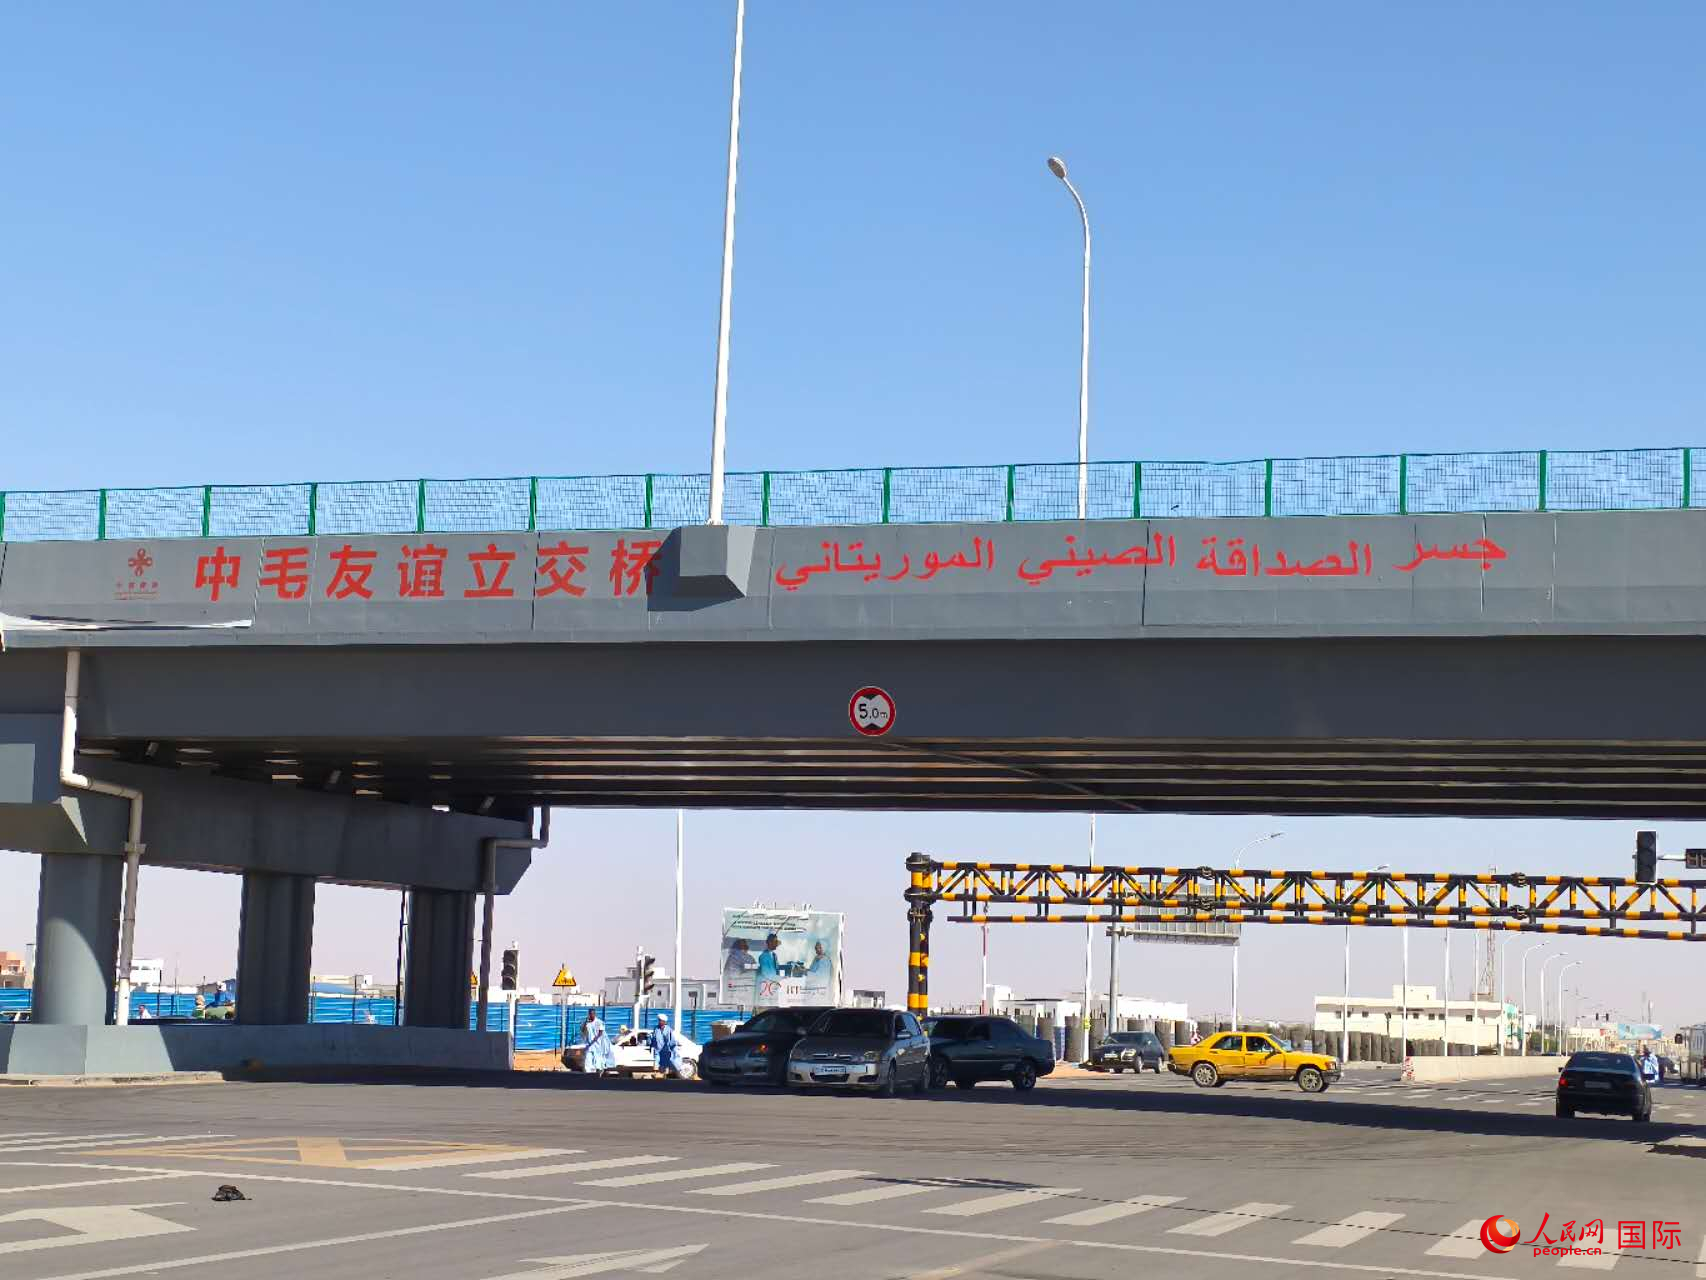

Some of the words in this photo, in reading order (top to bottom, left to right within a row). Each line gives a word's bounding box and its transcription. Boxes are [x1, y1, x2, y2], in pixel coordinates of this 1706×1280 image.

[194, 538, 663, 602] 中毛友谊立交桥
[774, 536, 995, 593] الموريتاني
[1016, 531, 1177, 587] الصيني
[1195, 535, 1374, 578] الصداقة
[1392, 537, 1508, 573] جسر
[858, 703, 888, 719] 5.0m
